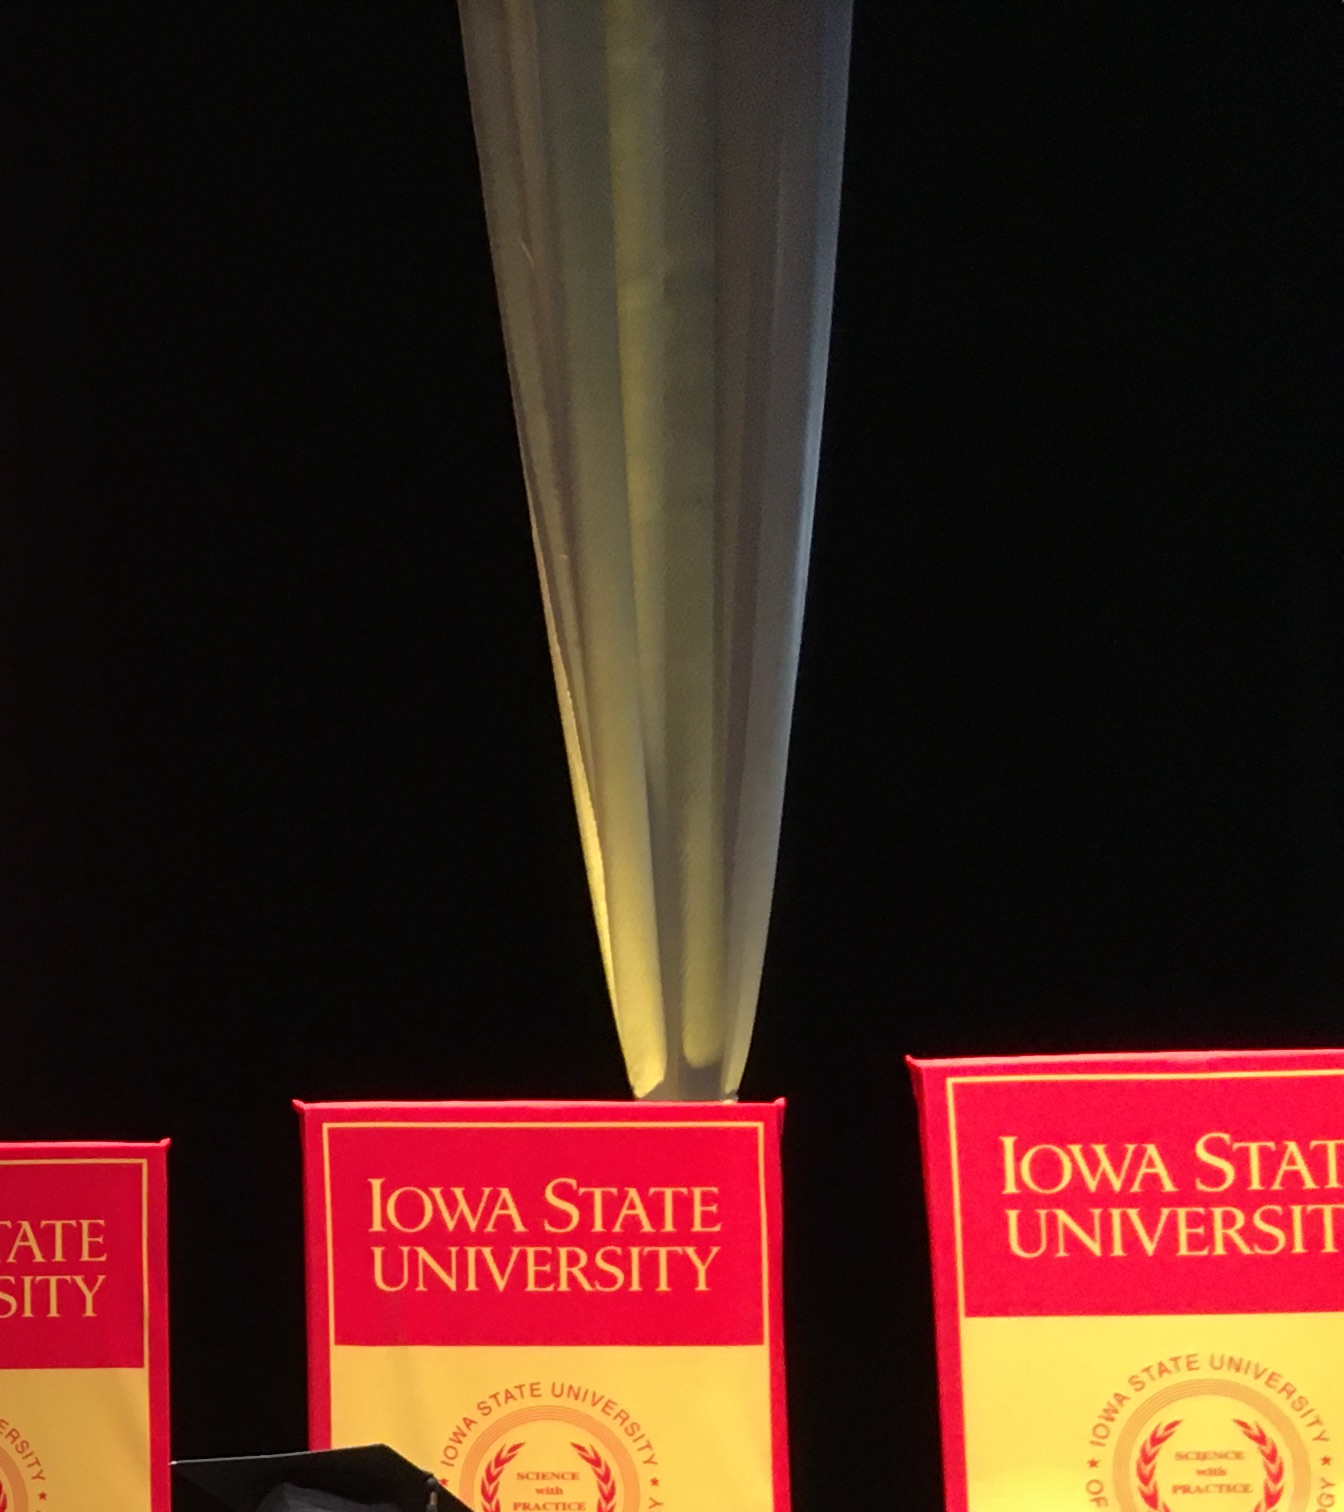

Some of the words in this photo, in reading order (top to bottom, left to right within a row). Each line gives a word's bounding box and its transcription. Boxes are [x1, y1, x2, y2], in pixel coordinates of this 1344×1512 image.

[1000, 1136, 1177, 1194] IOWA
[369, 1179, 526, 1232] IOWA
[544, 1178, 721, 1233] STATE
[372, 1246, 720, 1291] UNIVERSITY
[440, 1416, 478, 1467] IOWA
[476, 1381, 542, 1417] STATE
[550, 1381, 659, 1466] UNIVERSITY
[1088, 1392, 1130, 1447] IOWA
[1127, 1353, 1201, 1393] STATE
[1208, 1353, 1332, 1444] UNIVERSITY
[516, 1471, 580, 1481] SCIENCE
[535, 1485, 564, 1496] with
[512, 1501, 586, 1512] PRACTICE
